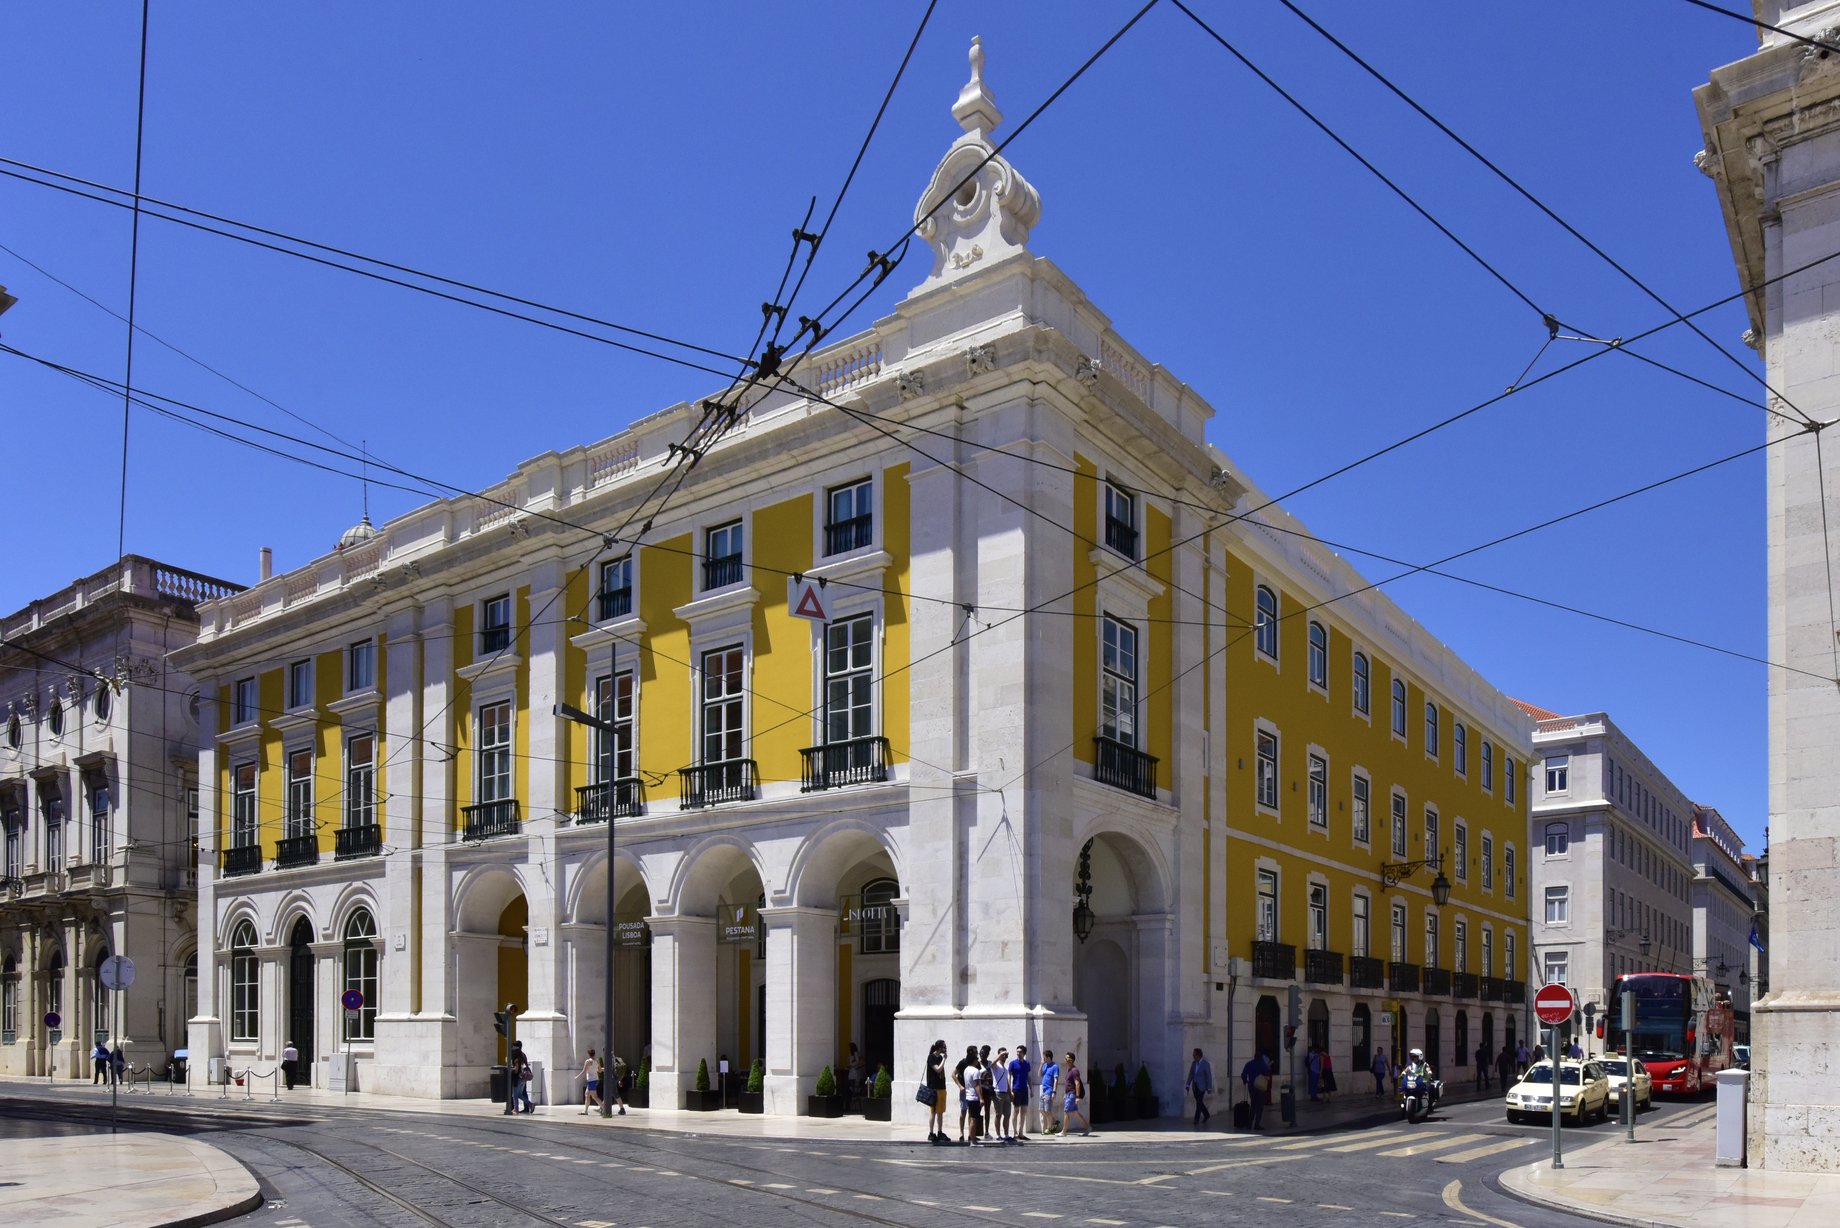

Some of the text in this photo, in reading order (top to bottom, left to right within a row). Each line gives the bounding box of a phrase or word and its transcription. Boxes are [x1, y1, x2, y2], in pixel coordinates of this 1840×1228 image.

[618, 922, 645, 930] POUSADA
[725, 926, 755, 935] PESTANA
[622, 931, 642, 939] LISBOA
